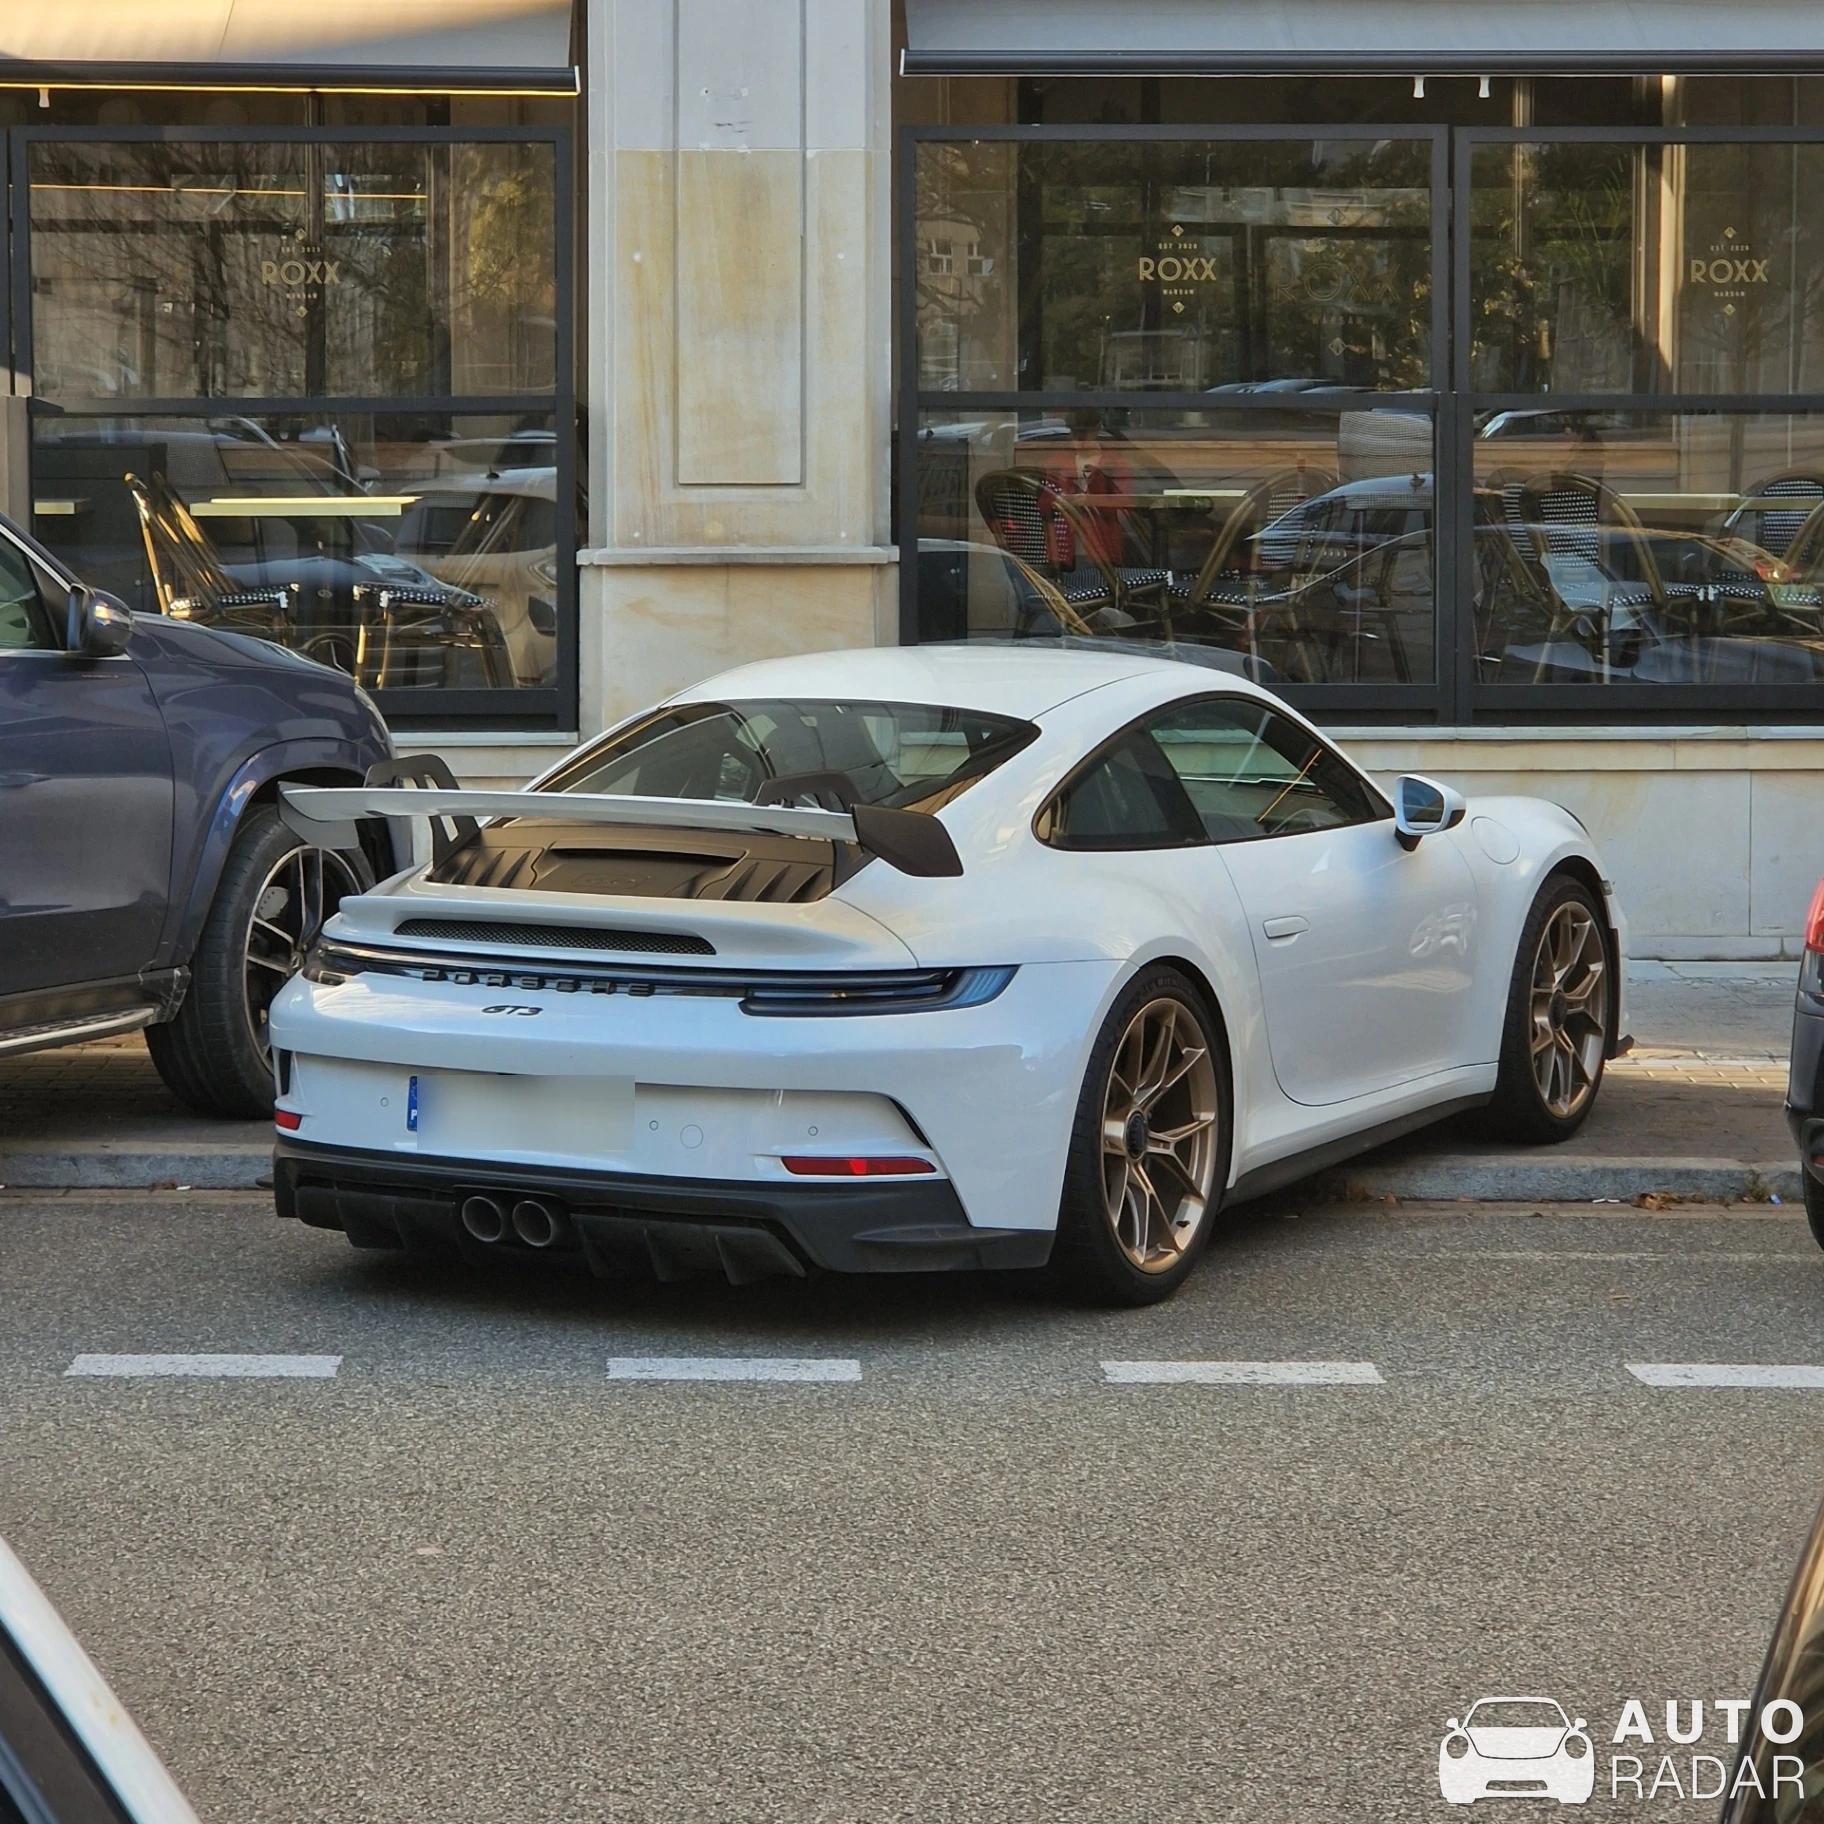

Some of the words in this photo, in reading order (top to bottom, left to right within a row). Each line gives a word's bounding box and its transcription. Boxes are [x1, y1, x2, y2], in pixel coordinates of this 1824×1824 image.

[261, 260, 340, 285] ROXX
[1139, 257, 1217, 281] ROXX
[1690, 259, 1768, 283] ROXX
[421, 967, 656, 998] PORSCHE
[481, 1004, 544, 1017] GT3
